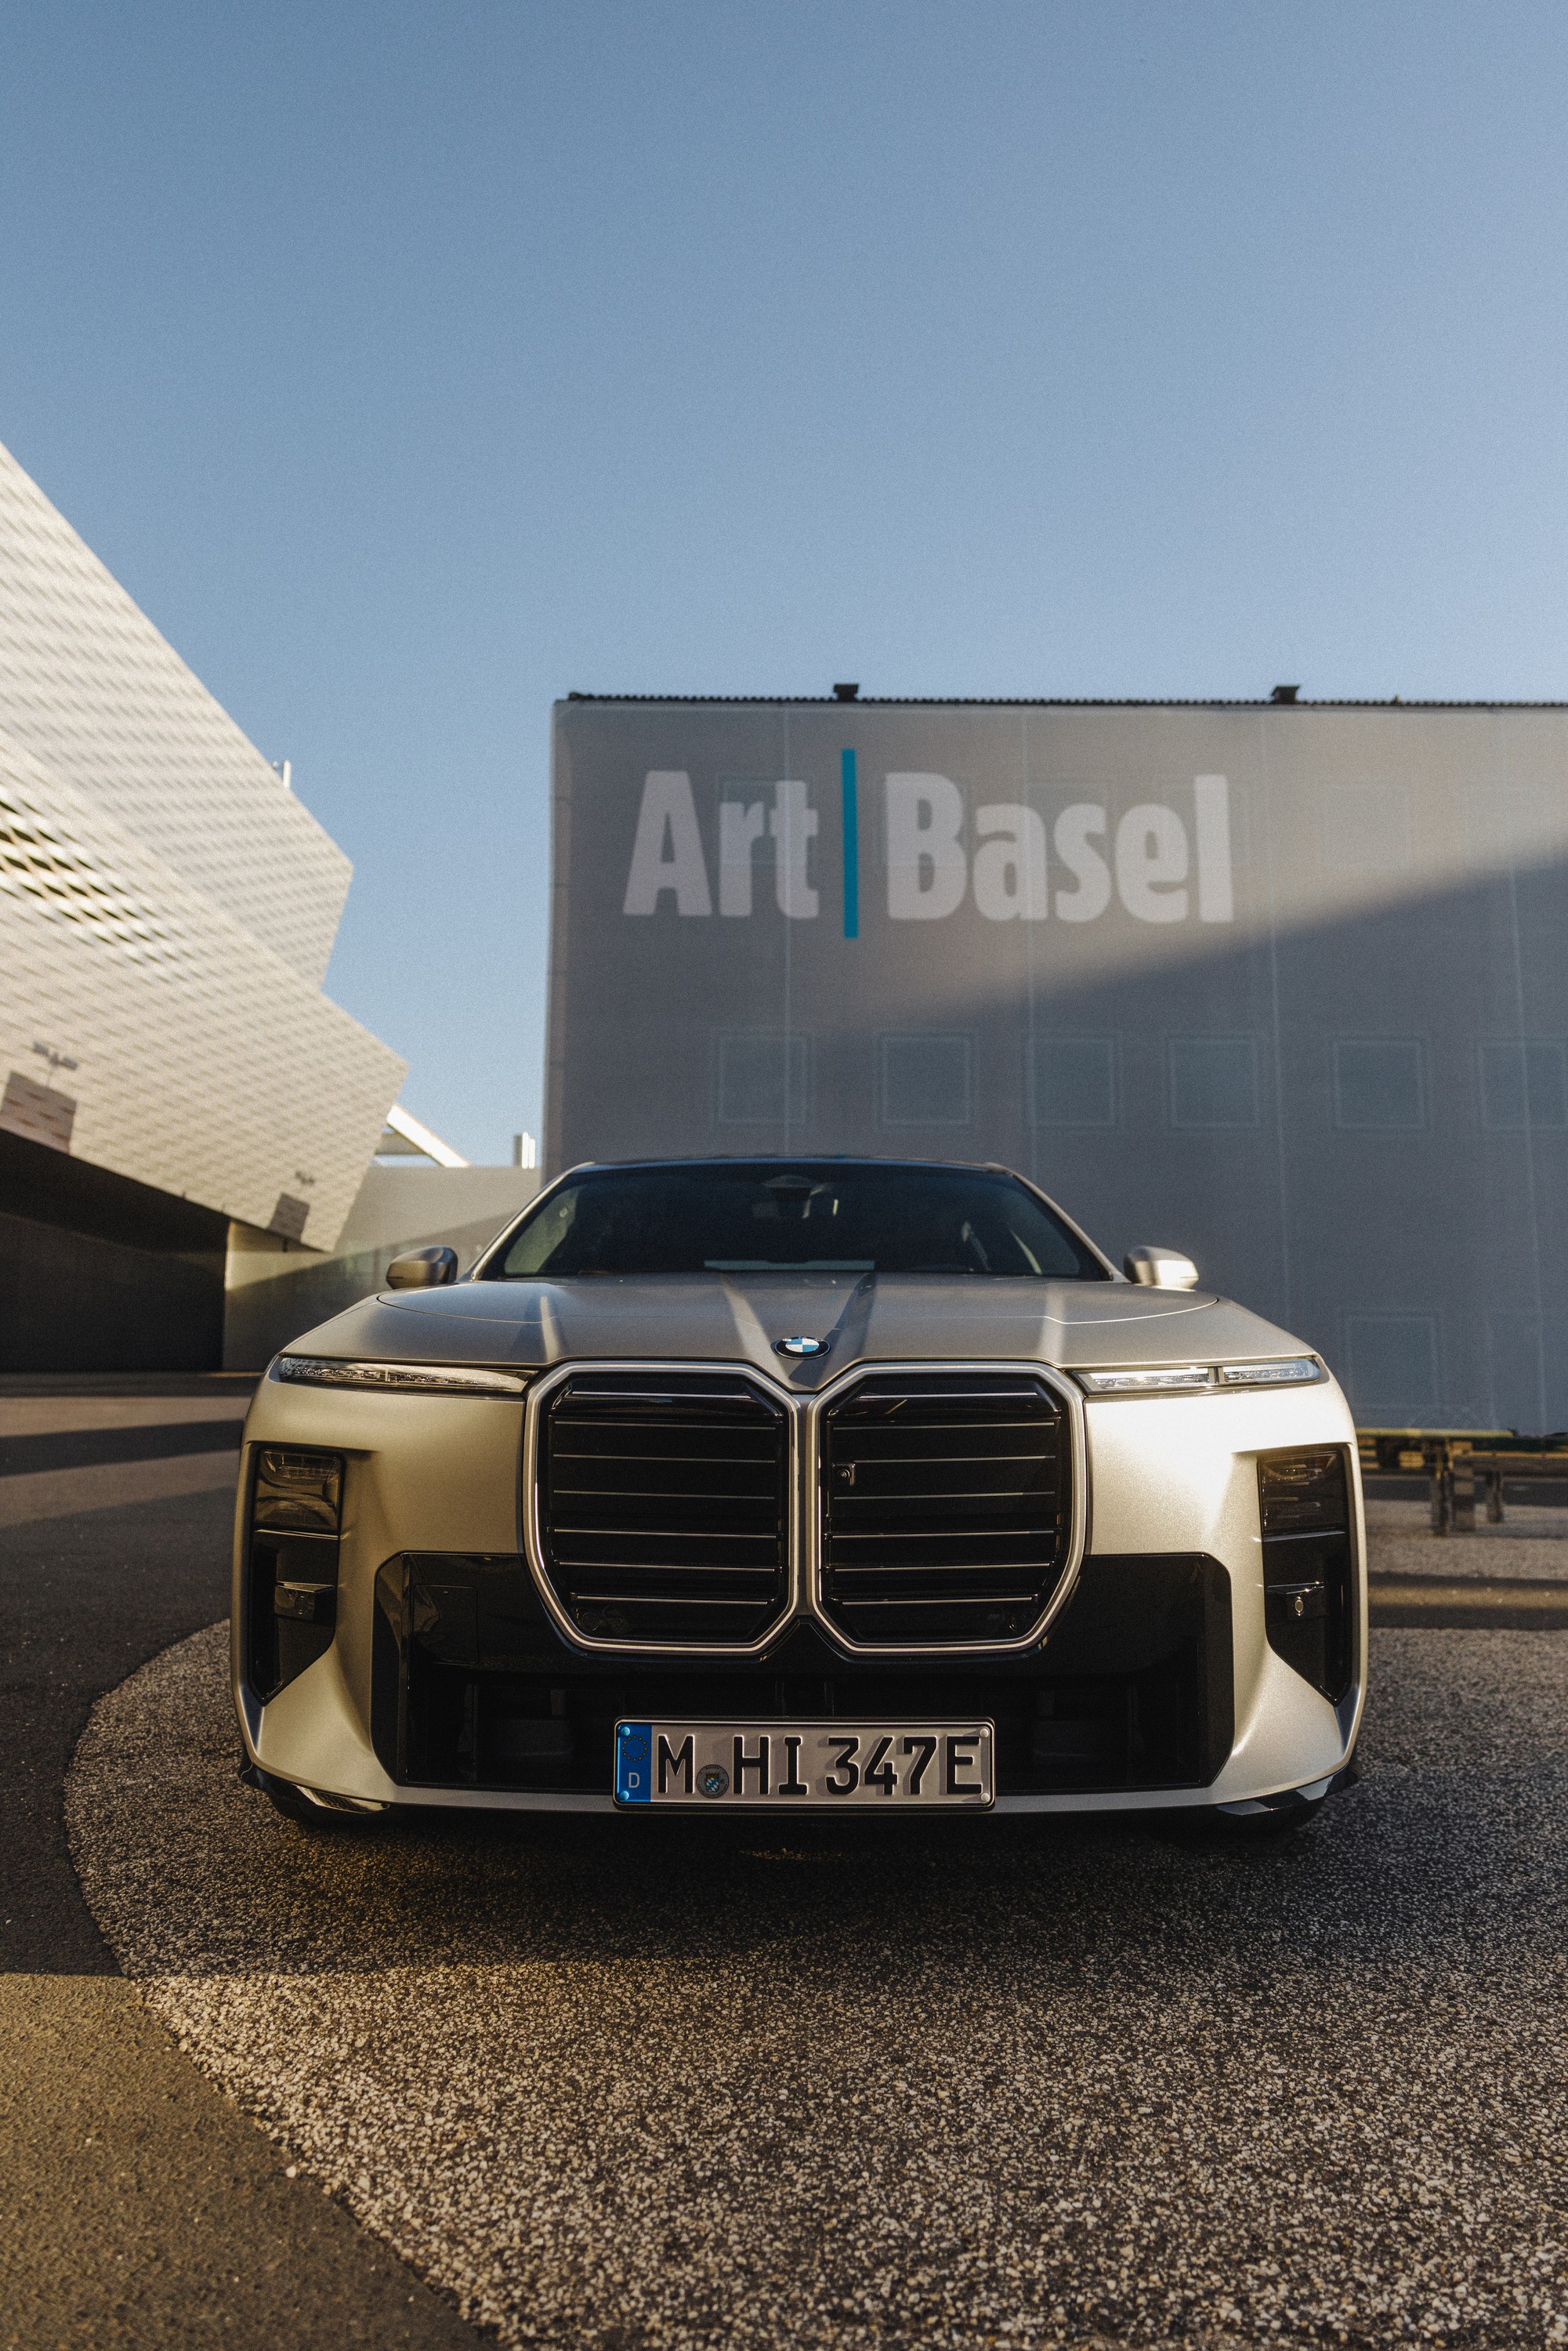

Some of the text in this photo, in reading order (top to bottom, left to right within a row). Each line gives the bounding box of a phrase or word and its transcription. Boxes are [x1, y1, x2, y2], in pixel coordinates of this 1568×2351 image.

[623, 770, 1233, 923] Art Basel
[628, 1772, 640, 1788] D
[657, 1735, 983, 1795] M HI 347E
